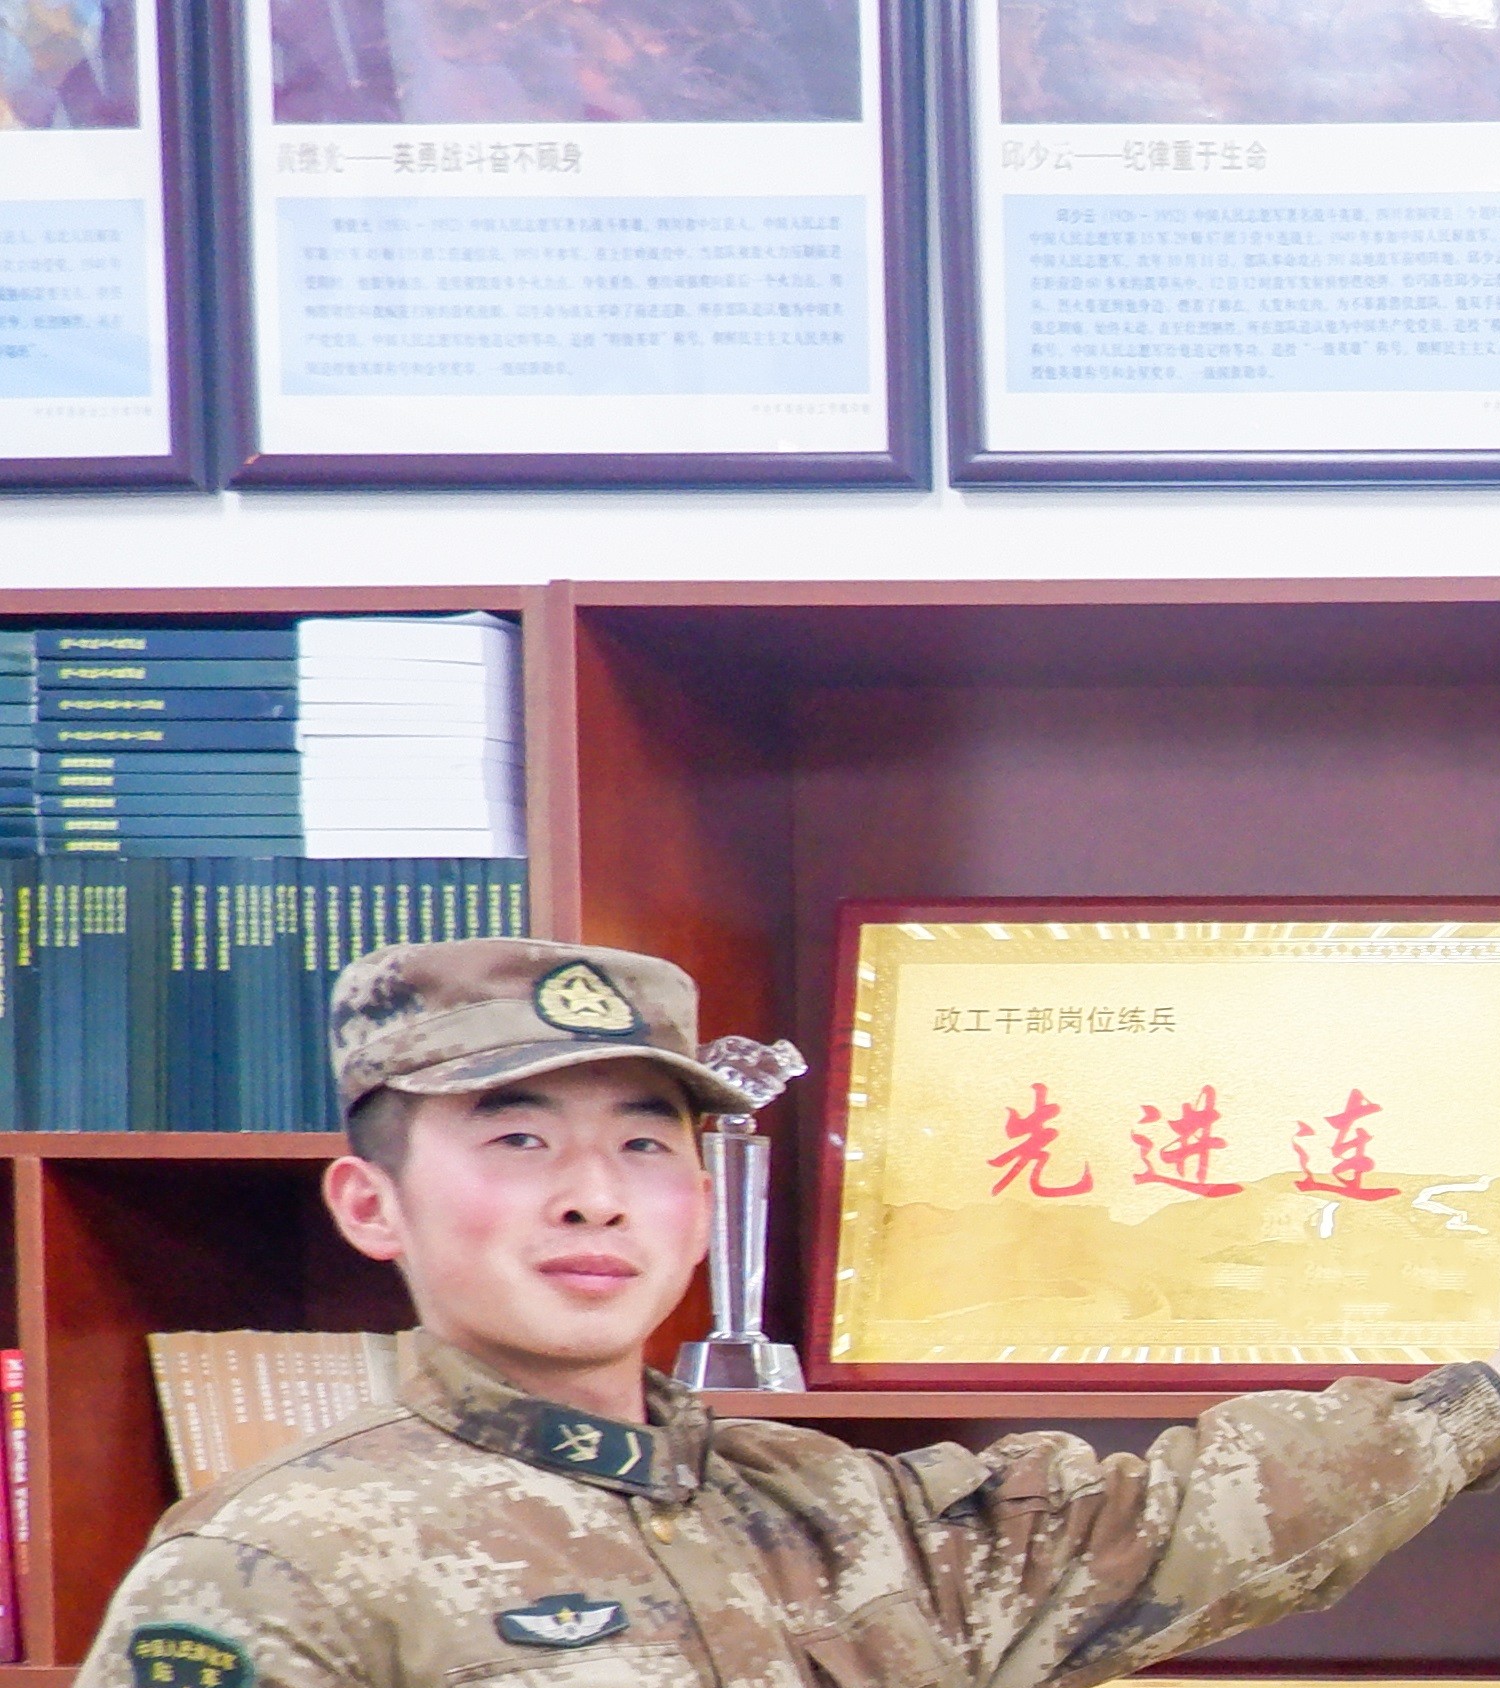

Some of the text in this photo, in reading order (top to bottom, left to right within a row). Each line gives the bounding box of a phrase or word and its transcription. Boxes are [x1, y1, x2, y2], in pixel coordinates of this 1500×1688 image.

[932, 1005, 1178, 1036] 政工干部岗位练兵
[987, 1082, 1402, 1201] 先进连
